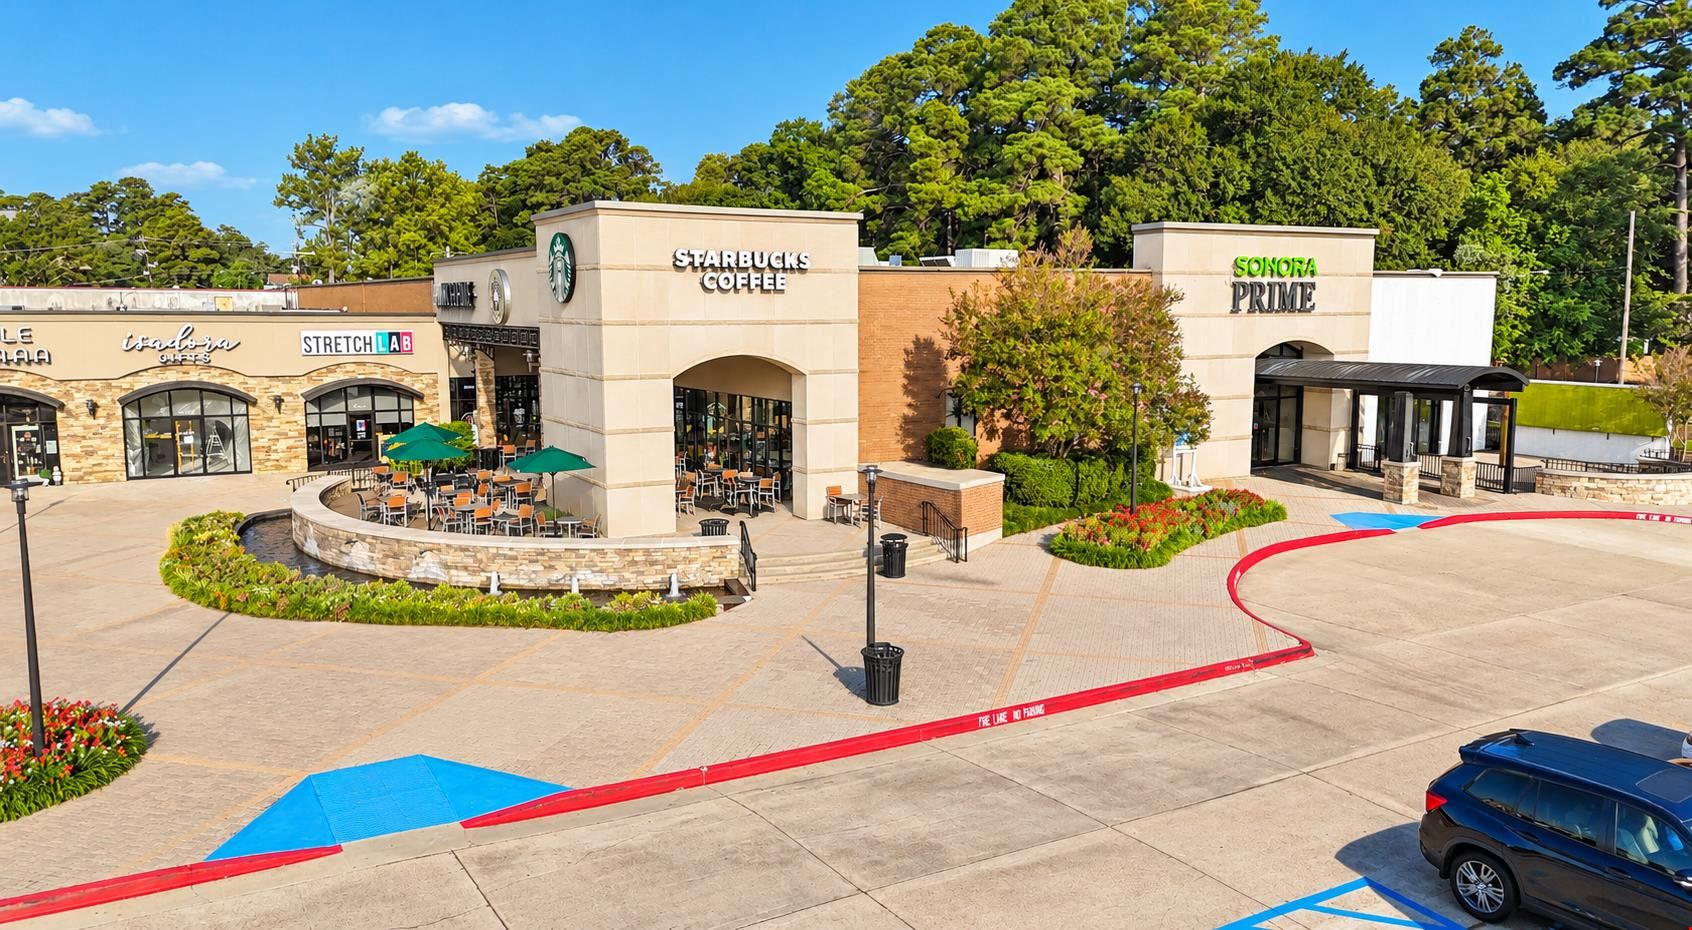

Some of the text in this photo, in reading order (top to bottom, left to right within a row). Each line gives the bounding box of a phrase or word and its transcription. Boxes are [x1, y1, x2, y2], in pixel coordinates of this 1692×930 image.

[673, 249, 812, 270] STARBUCKS
[1234, 256, 1318, 277] SONORA
[701, 272, 787, 292] COFFEE
[1230, 281, 1316, 313] PRIME
[122, 323, 241, 352] isadora
[159, 353, 211, 363] GIFTS
